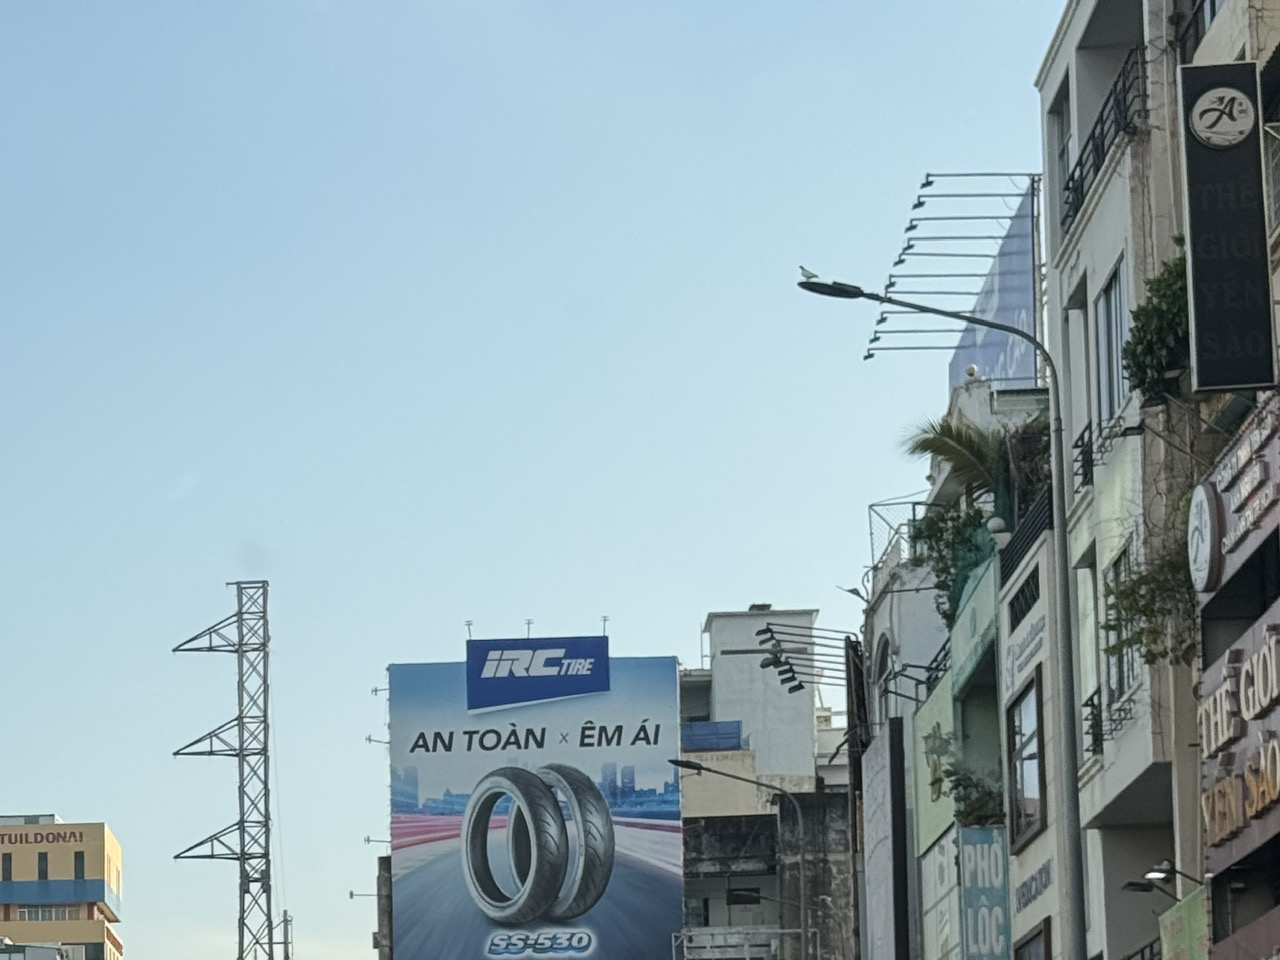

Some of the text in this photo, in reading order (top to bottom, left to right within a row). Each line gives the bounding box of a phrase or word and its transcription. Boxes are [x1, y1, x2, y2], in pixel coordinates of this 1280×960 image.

[480, 648, 595, 678] IRC TIRE
[409, 731, 454, 753] AN
[462, 722, 547, 751] TOÀN
[579, 720, 623, 748] ÊM
[631, 718, 660, 746] ÁI
[487, 932, 593, 955] SS-530
